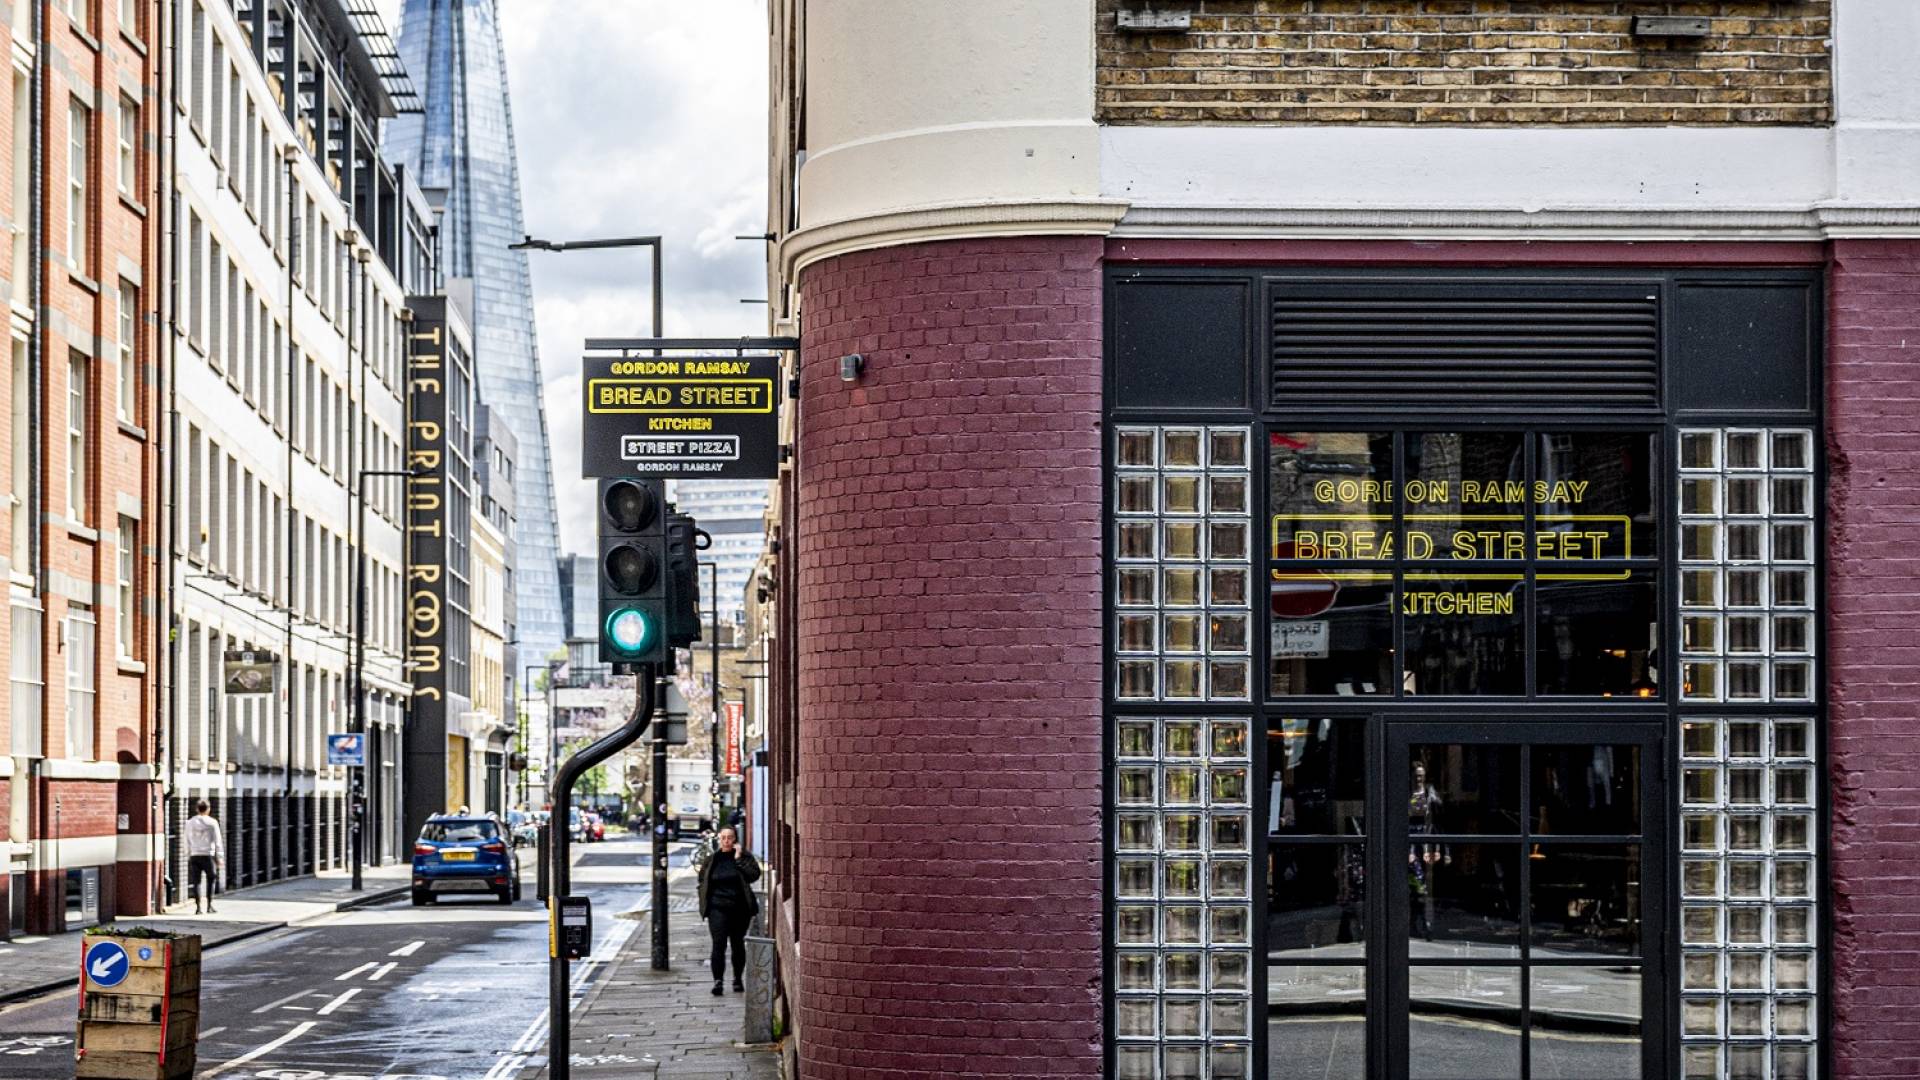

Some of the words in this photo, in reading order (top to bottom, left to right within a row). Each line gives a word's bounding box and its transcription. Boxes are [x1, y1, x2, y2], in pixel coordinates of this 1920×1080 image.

[409, 326, 440, 395] THE
[610, 362, 679, 375] GORDON
[684, 362, 750, 375] RAMSAY
[600, 387, 672, 405] BREAD
[680, 387, 760, 405] STREET
[648, 418, 712, 431] KITCHEN
[627, 442, 684, 454] STREET
[689, 442, 733, 454] PIZZA
[637, 463, 680, 472] GORDON
[682, 463, 723, 472] RAMSAY
[409, 420, 440, 538] PRINT
[1461, 480, 1588, 503] RAMSAY
[1294, 531, 1433, 560] BREAD
[1452, 531, 1608, 560] STREET
[409, 564, 440, 702] ROOMS
